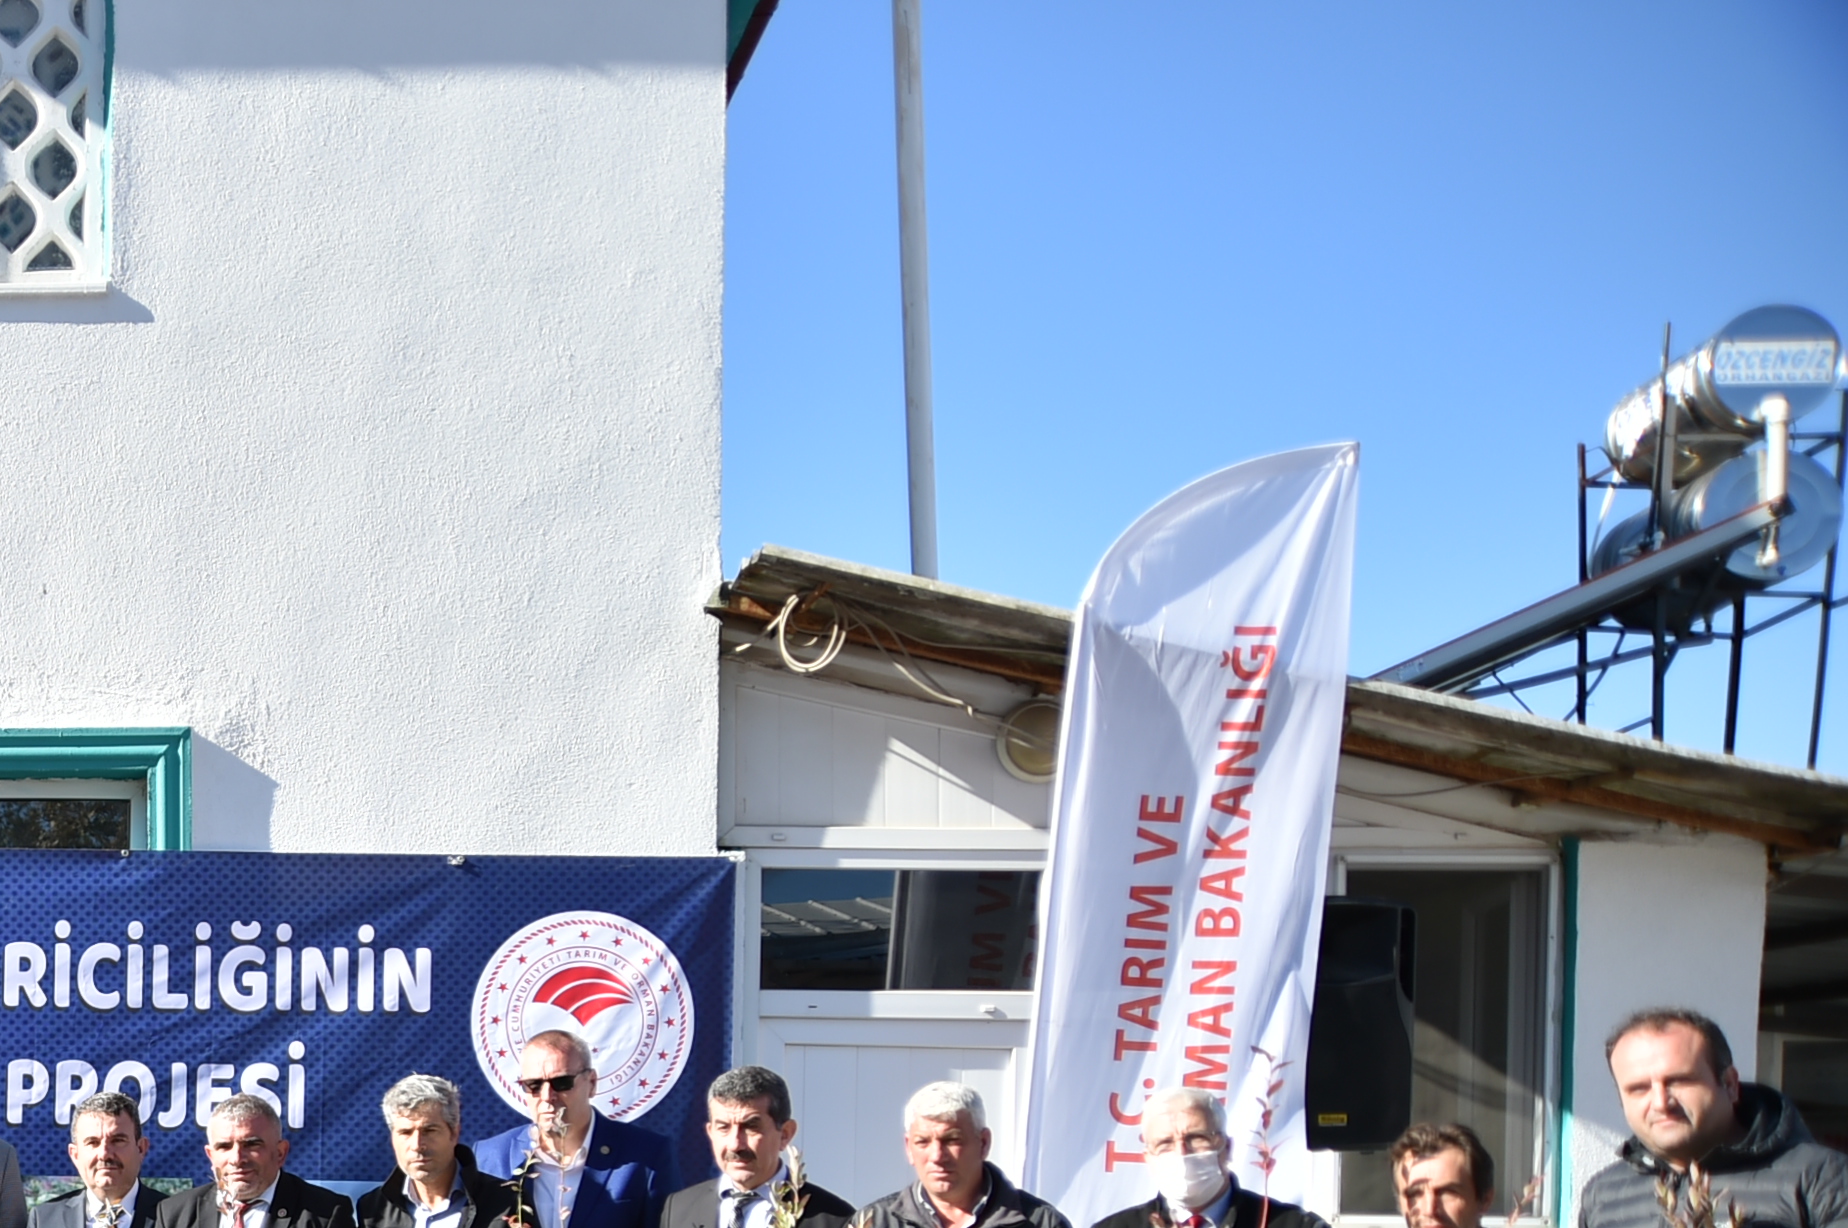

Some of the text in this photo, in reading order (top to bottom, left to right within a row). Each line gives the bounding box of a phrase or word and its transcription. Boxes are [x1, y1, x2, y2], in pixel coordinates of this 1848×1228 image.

[1135, 795, 1184, 864] VE
[1183, 626, 1278, 1104] MAN BAKANLIĞI
[511, 952, 561, 1032] CUMHURİYETİ
[566, 949, 608, 961] TARIM
[1115, 885, 1172, 1060] TARIM
[631, 971, 656, 1018] ORMAN
[6, 1040, 306, 1129] PROJESİ
[609, 1023, 656, 1086] BAKANLIĞI
